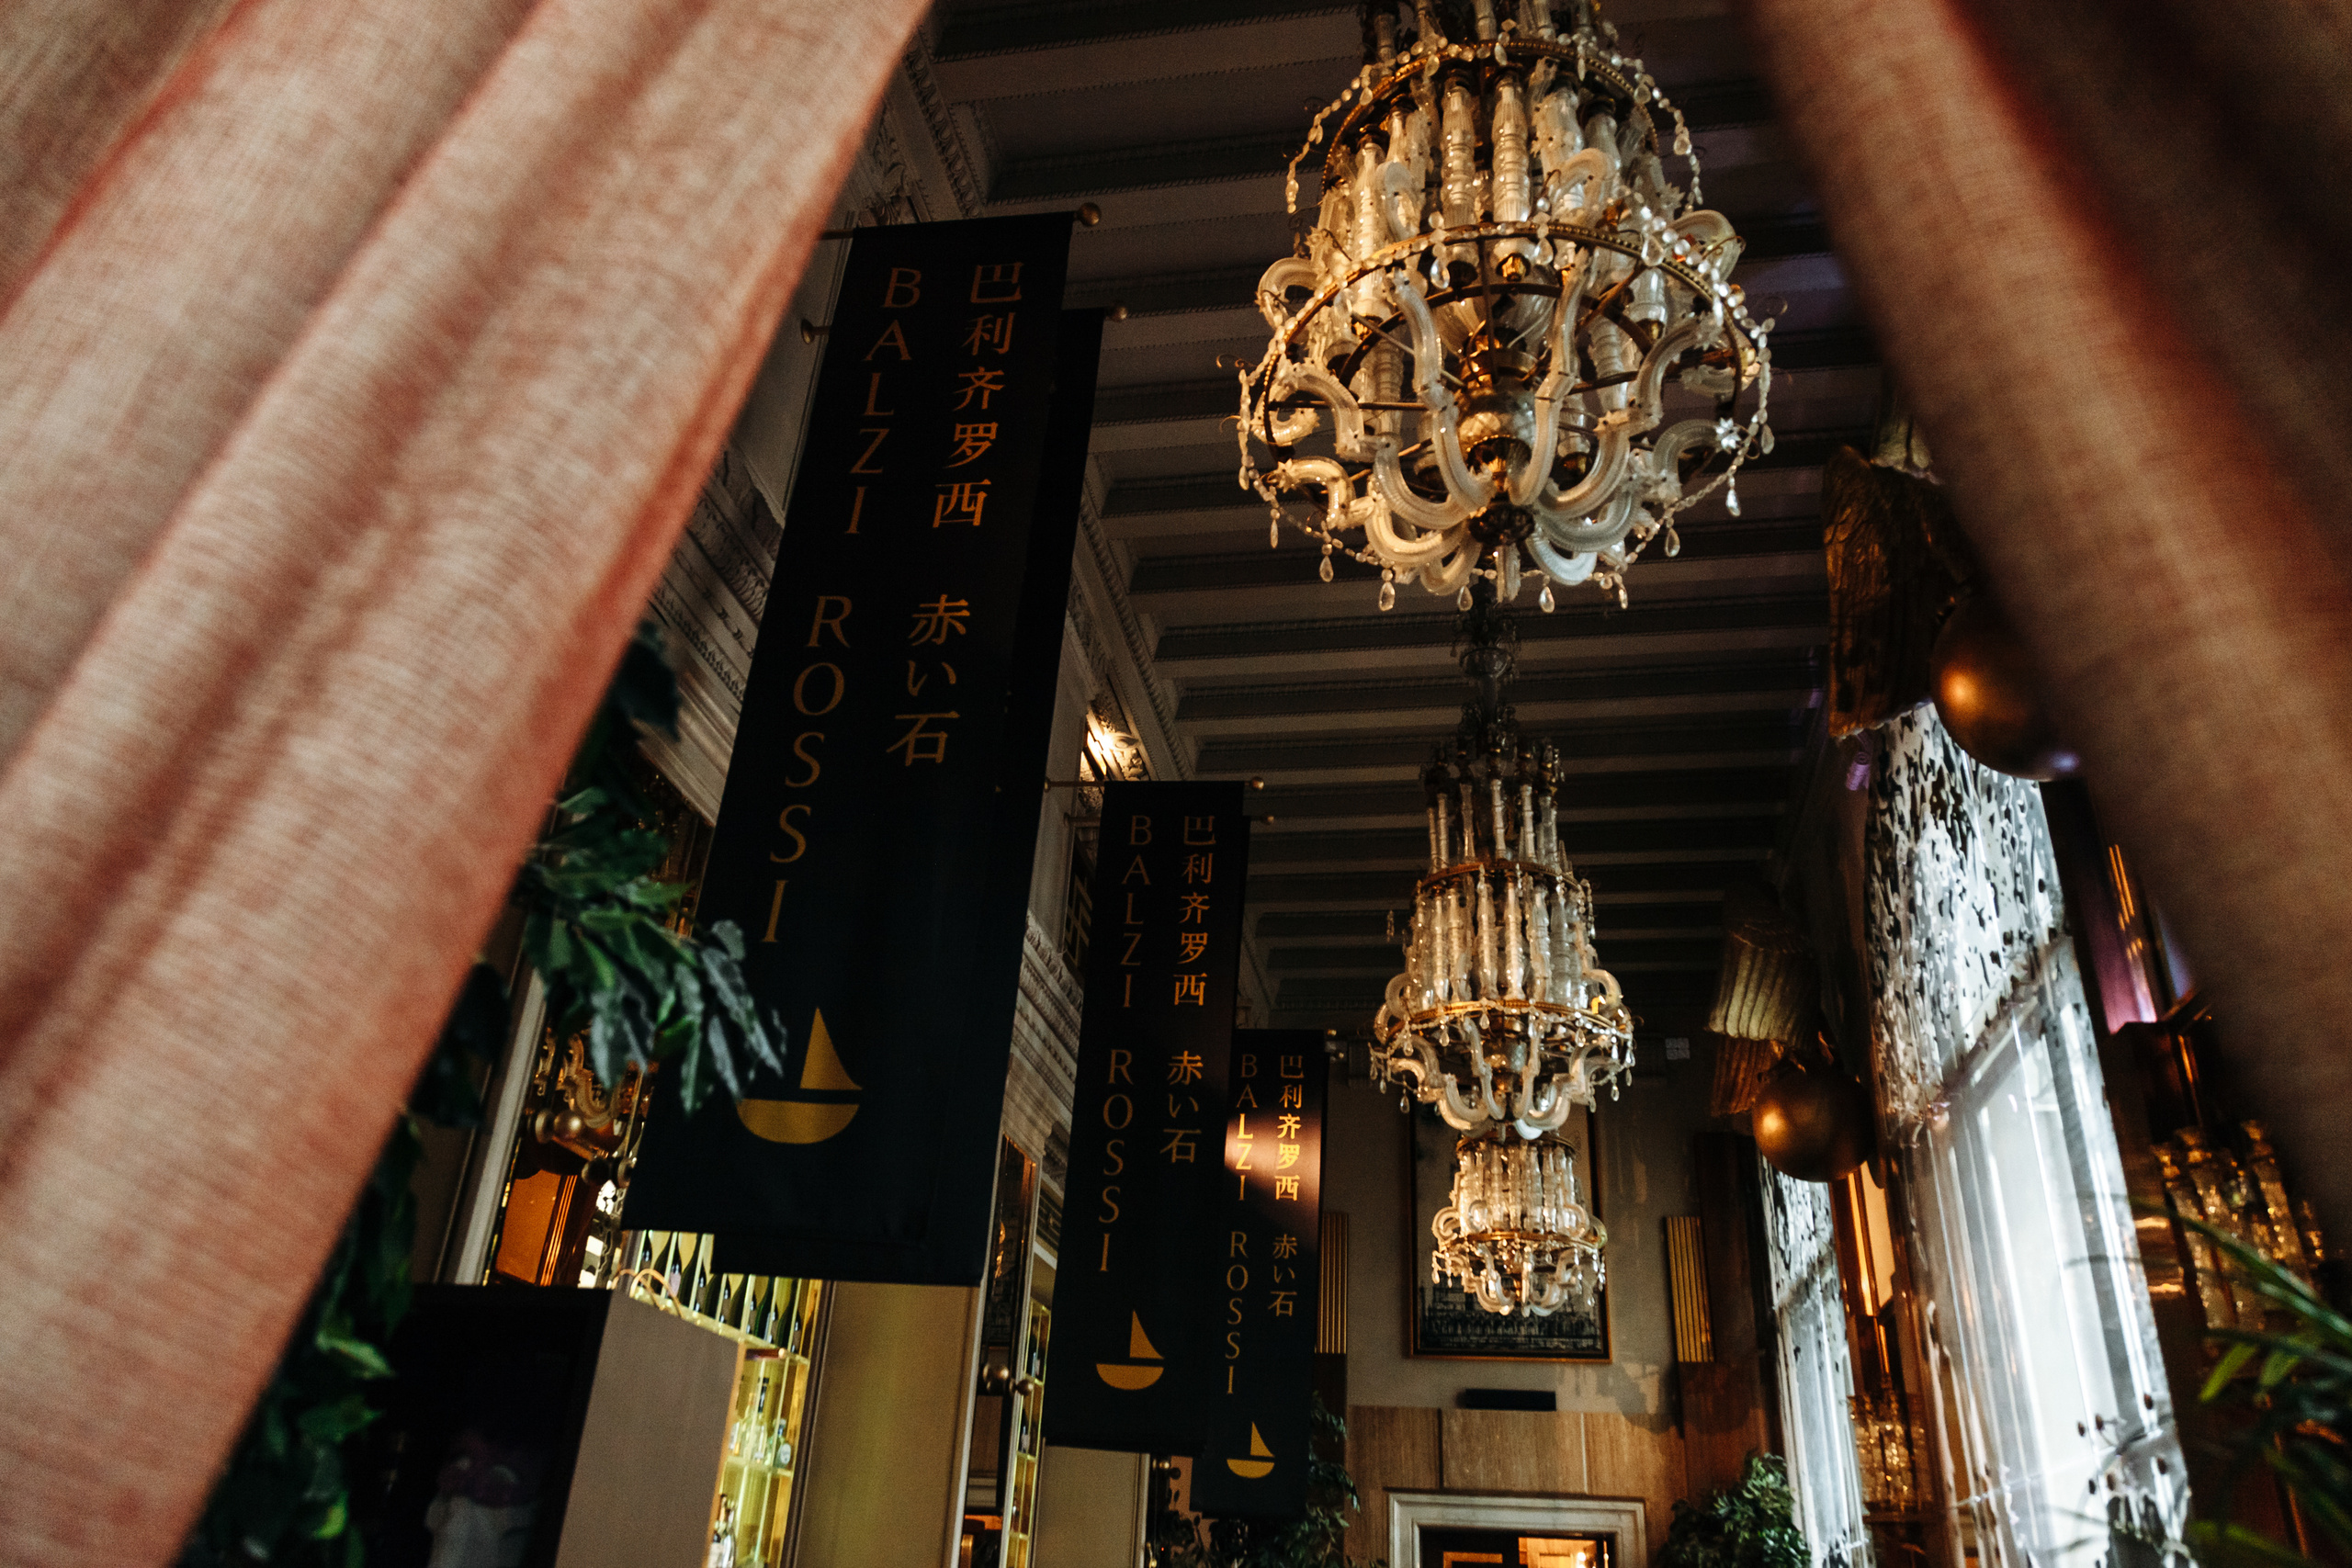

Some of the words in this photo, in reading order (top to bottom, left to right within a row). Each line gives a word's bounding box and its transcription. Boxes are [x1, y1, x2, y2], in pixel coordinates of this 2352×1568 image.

[844, 266, 922, 535] BALZI
[932, 261, 1024, 529] 巴利齐罗西
[761, 594, 853, 943] ROSSI
[886, 593, 971, 766] 赤い石
[1120, 815, 1153, 1009] BALZI
[1172, 815, 1216, 1006] 巴利齐罗西
[1098, 1049, 1135, 1272] ROSSI
[1159, 1050, 1204, 1164] 赤い石
[1236, 1054, 1259, 1201] BALZI
[1274, 1055, 1305, 1201] 巴利齐罗西
[1225, 1231, 1249, 1394] ROSSI
[1268, 1234, 1298, 1317] 赤い石
